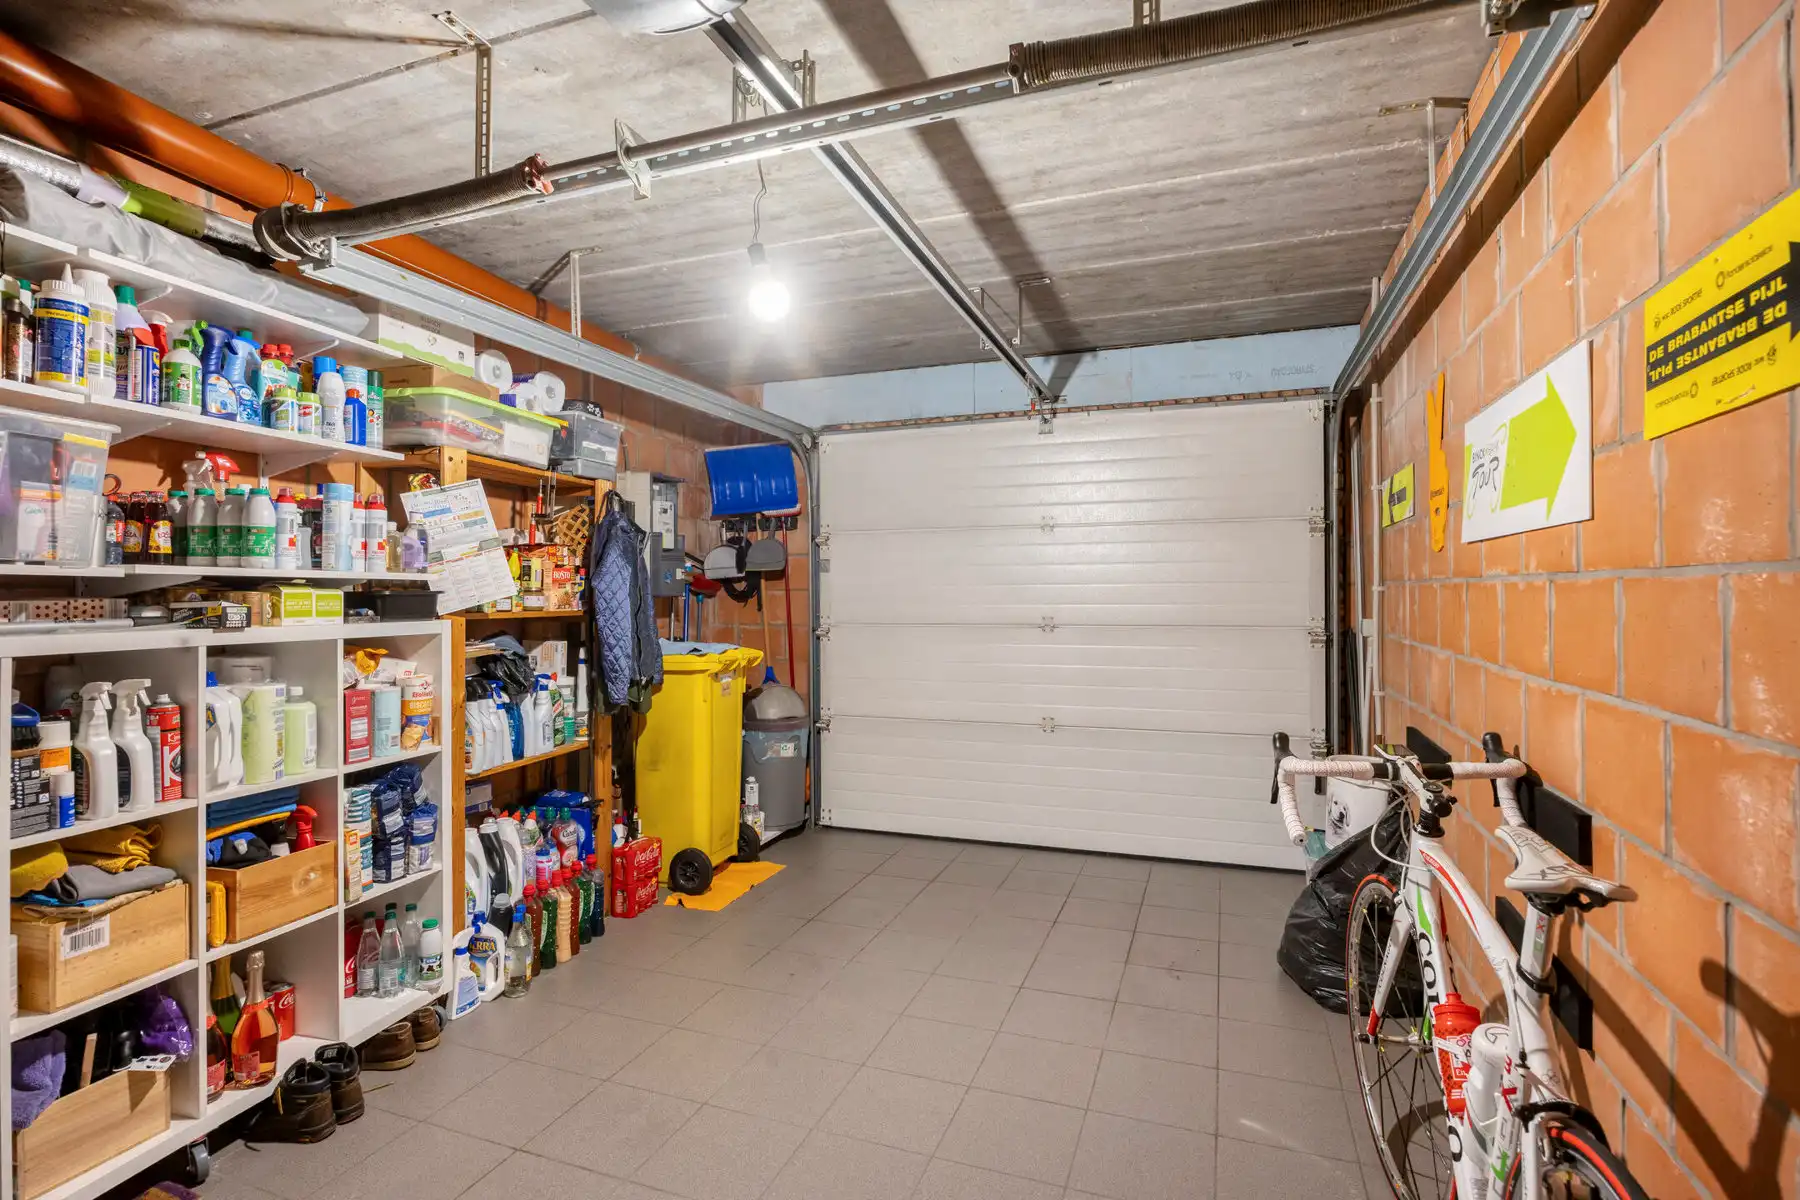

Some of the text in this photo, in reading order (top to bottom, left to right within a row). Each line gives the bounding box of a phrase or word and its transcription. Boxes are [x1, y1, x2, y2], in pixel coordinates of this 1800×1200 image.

[1648, 300, 1787, 381] DE BRABANTSE PIJL
[1649, 276, 1787, 363] DE BRABANTSE PIJL
